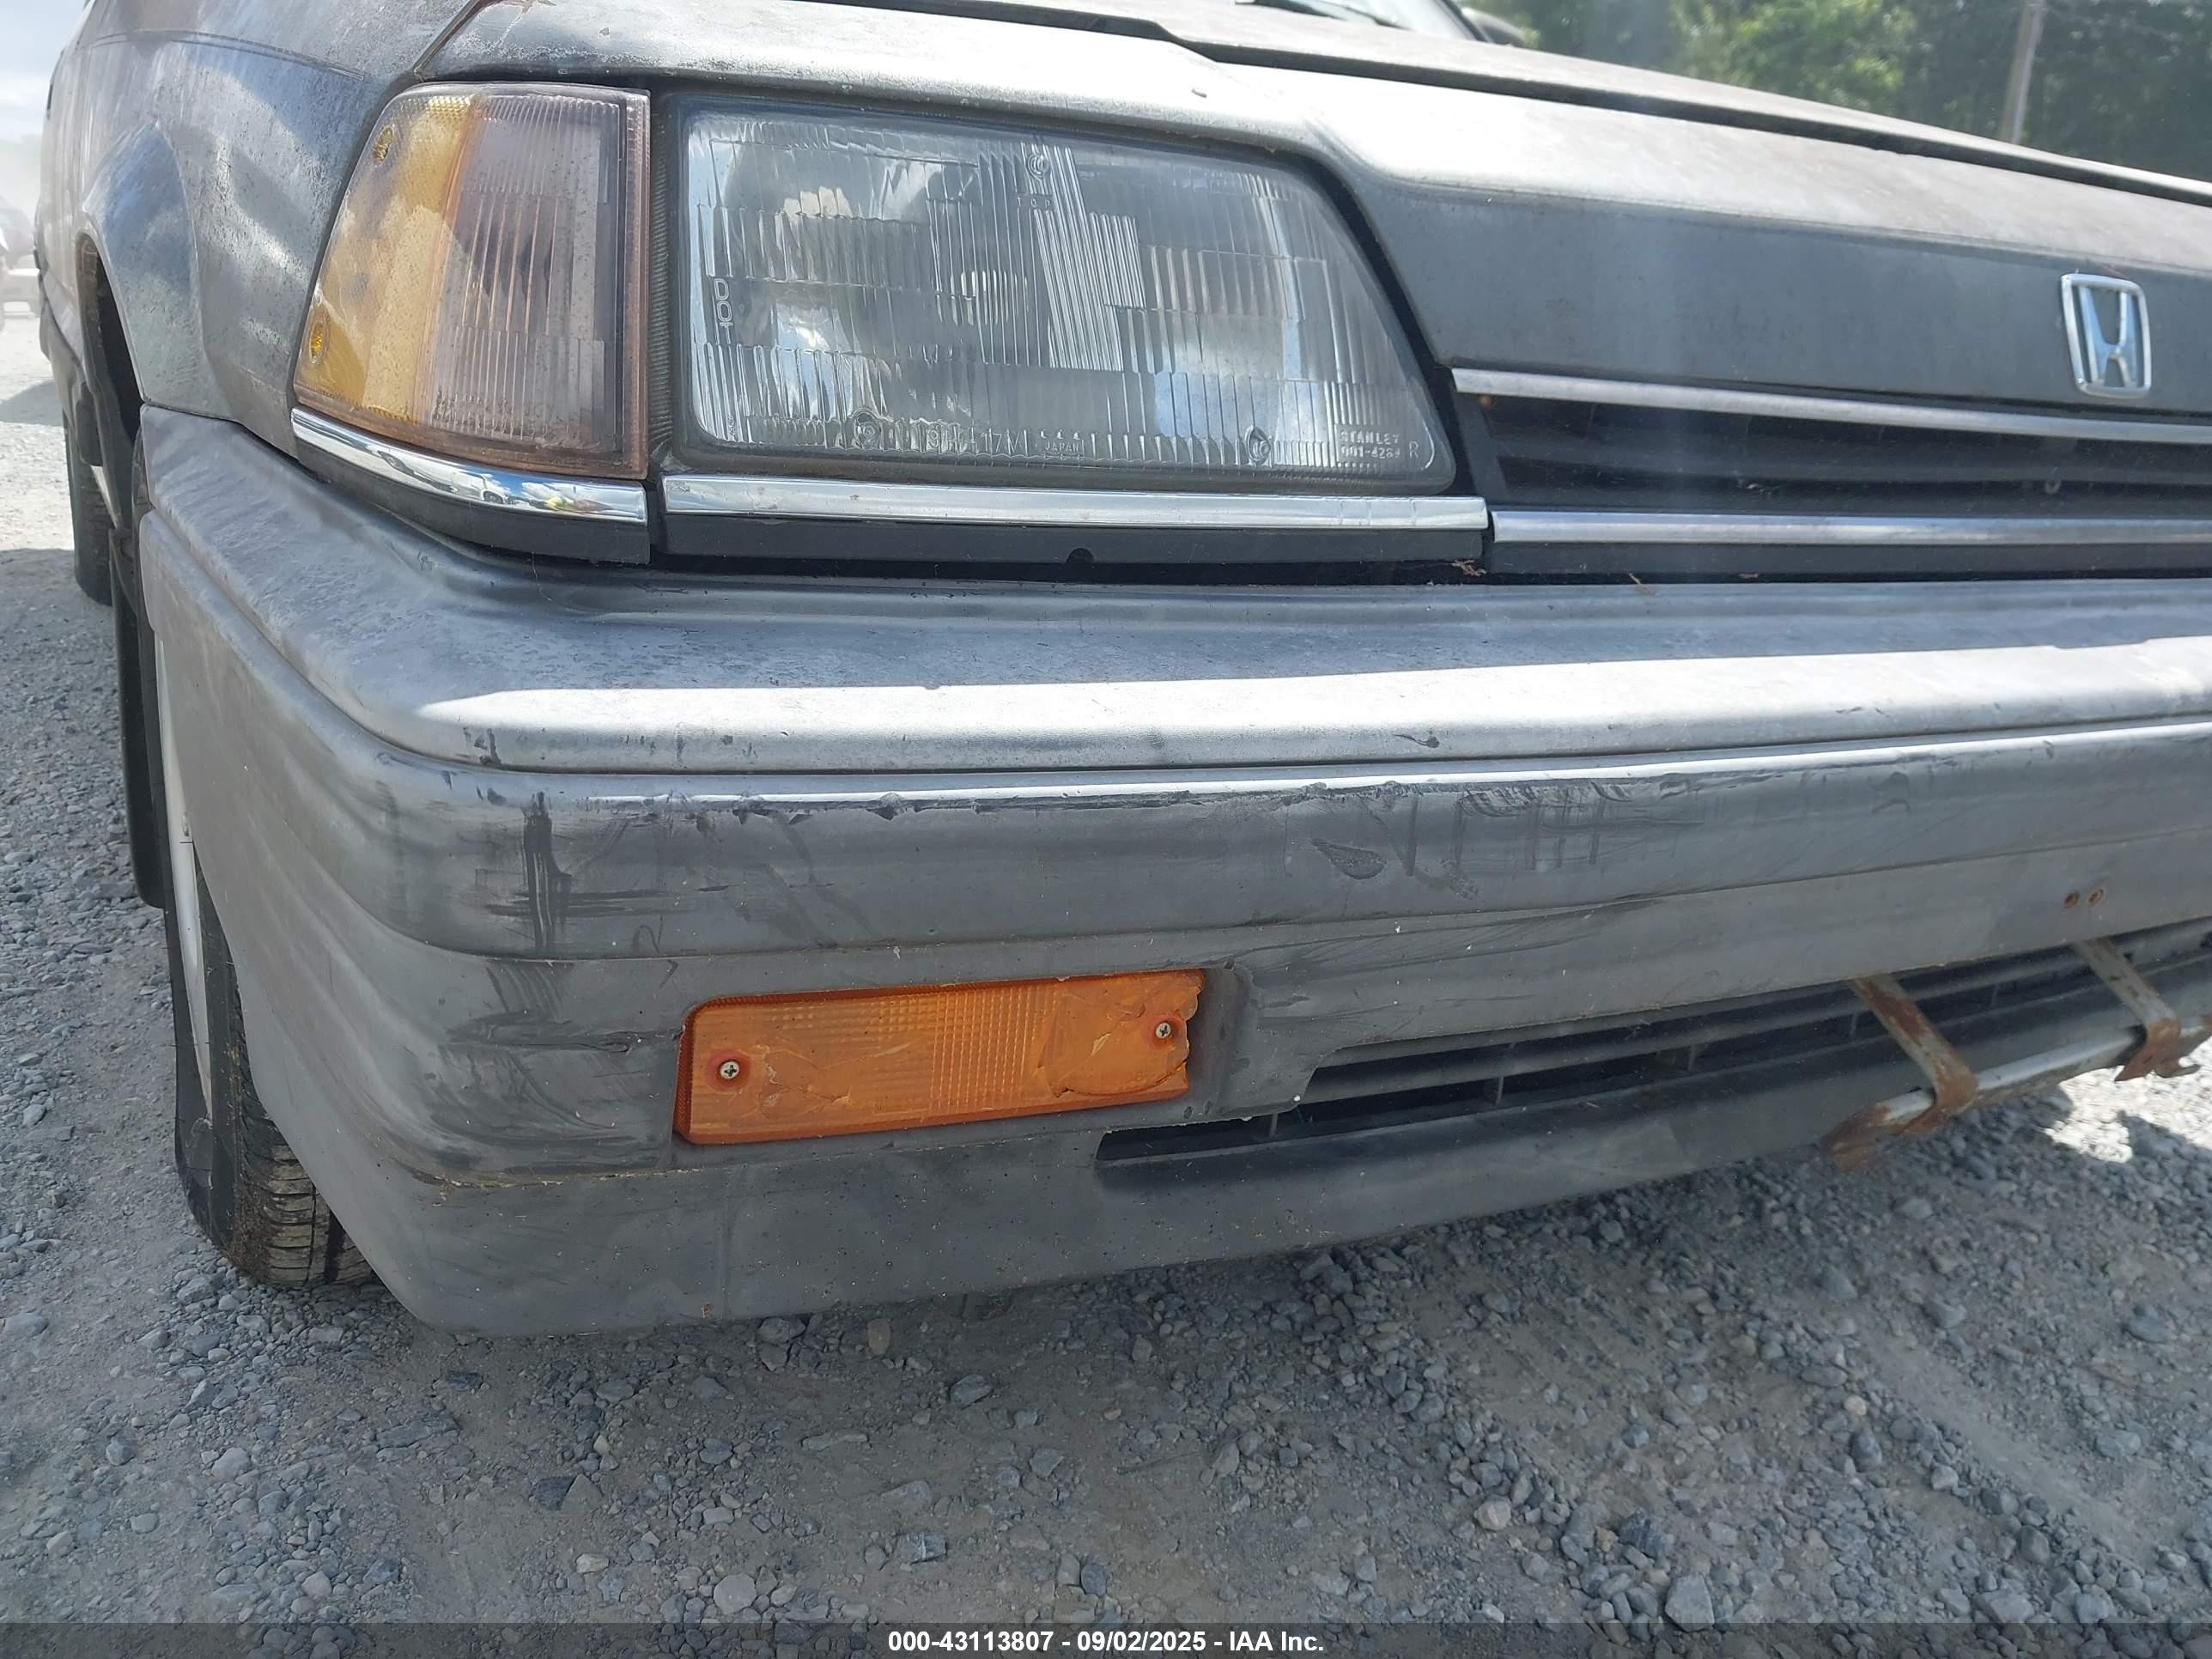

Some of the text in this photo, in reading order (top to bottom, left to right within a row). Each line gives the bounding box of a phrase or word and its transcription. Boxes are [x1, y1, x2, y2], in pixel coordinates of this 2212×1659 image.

[714, 277, 734, 344] DOT
[1340, 430, 1401, 445] STANLEY
[1046, 440, 1079, 453] JAPAN
[1408, 441, 1419, 459] R
